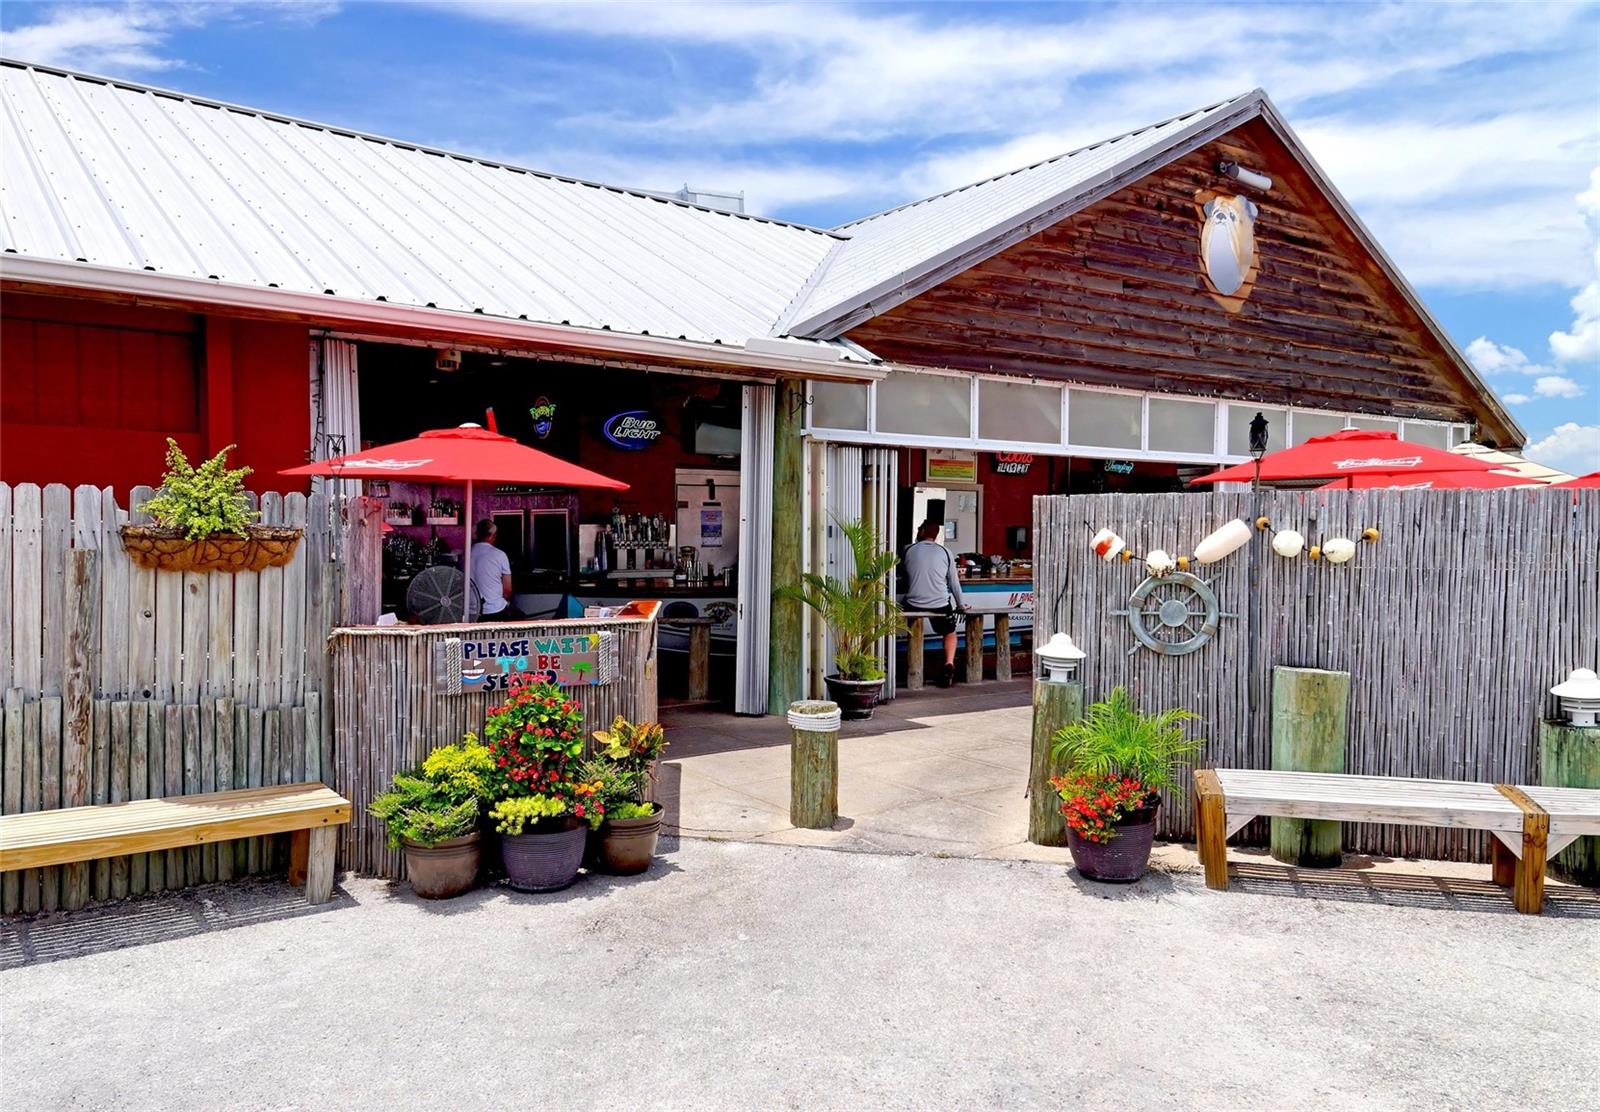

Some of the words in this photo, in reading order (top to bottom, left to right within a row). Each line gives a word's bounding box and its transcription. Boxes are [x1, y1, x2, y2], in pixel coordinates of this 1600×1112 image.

[621, 416, 657, 430] BUD
[613, 426, 661, 440] LIGHT
[463, 639, 530, 659] PLEASE
[534, 637, 590, 654] WAIT
[496, 656, 528, 673] TO
[537, 654, 561, 670] BE
